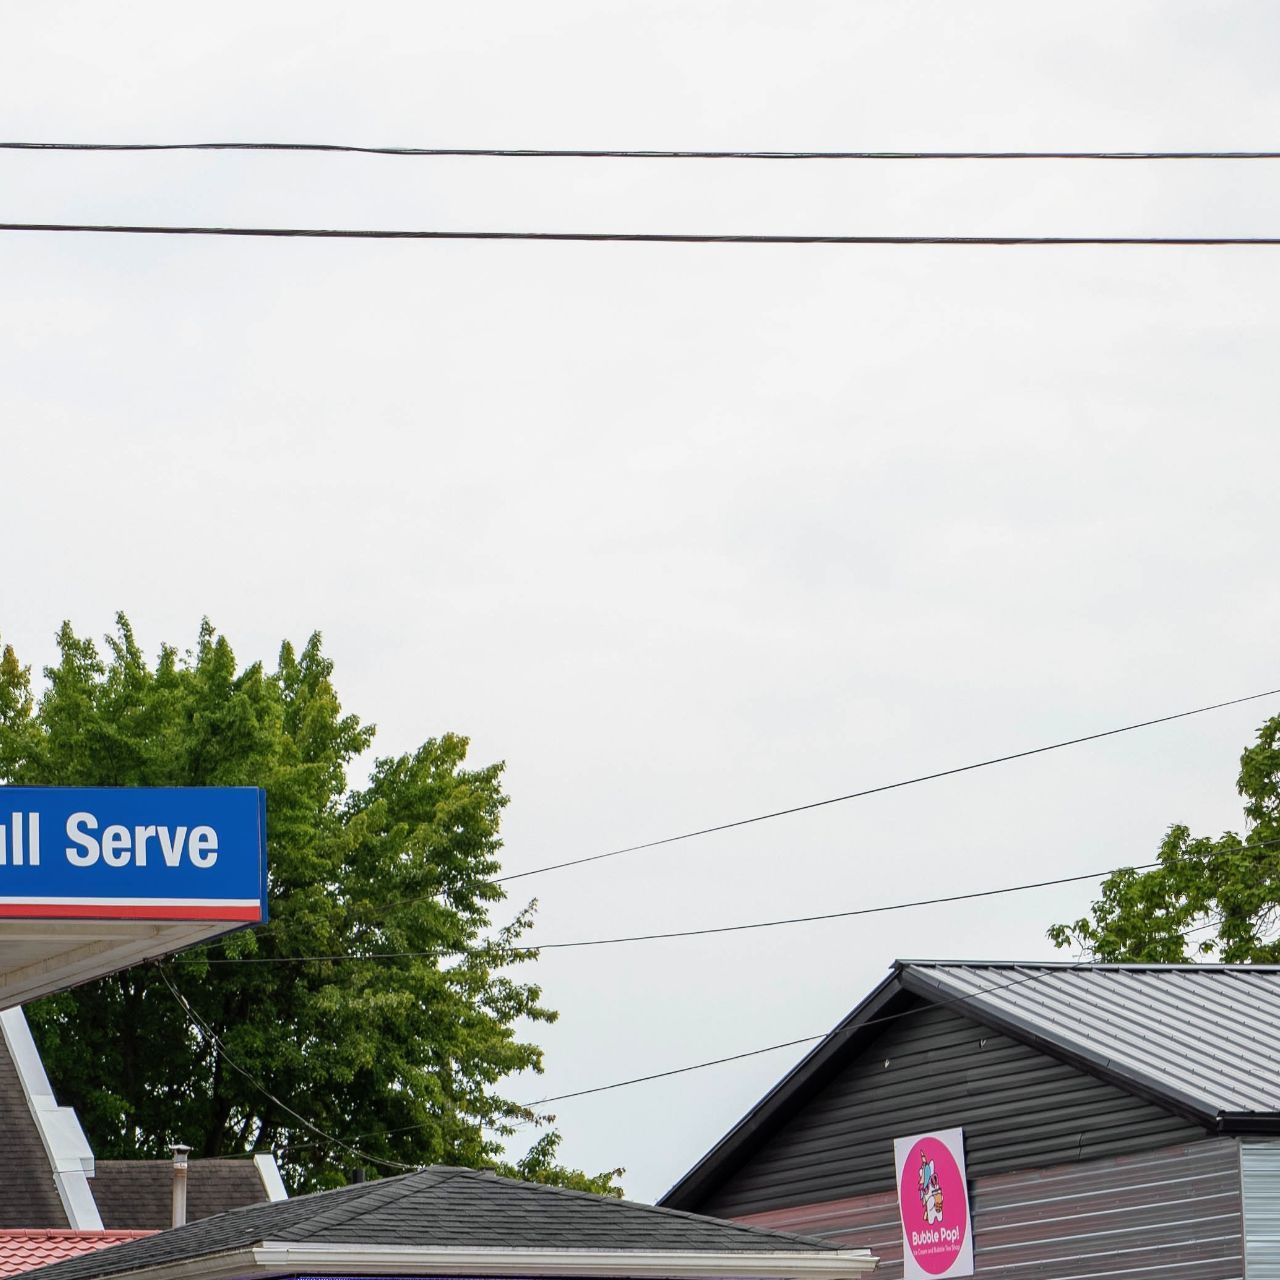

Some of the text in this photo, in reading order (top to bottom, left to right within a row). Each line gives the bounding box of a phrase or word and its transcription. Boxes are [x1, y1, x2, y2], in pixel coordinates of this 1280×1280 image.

[65, 812, 218, 868] Serve
[912, 1225, 960, 1246] Bubble Pop!
